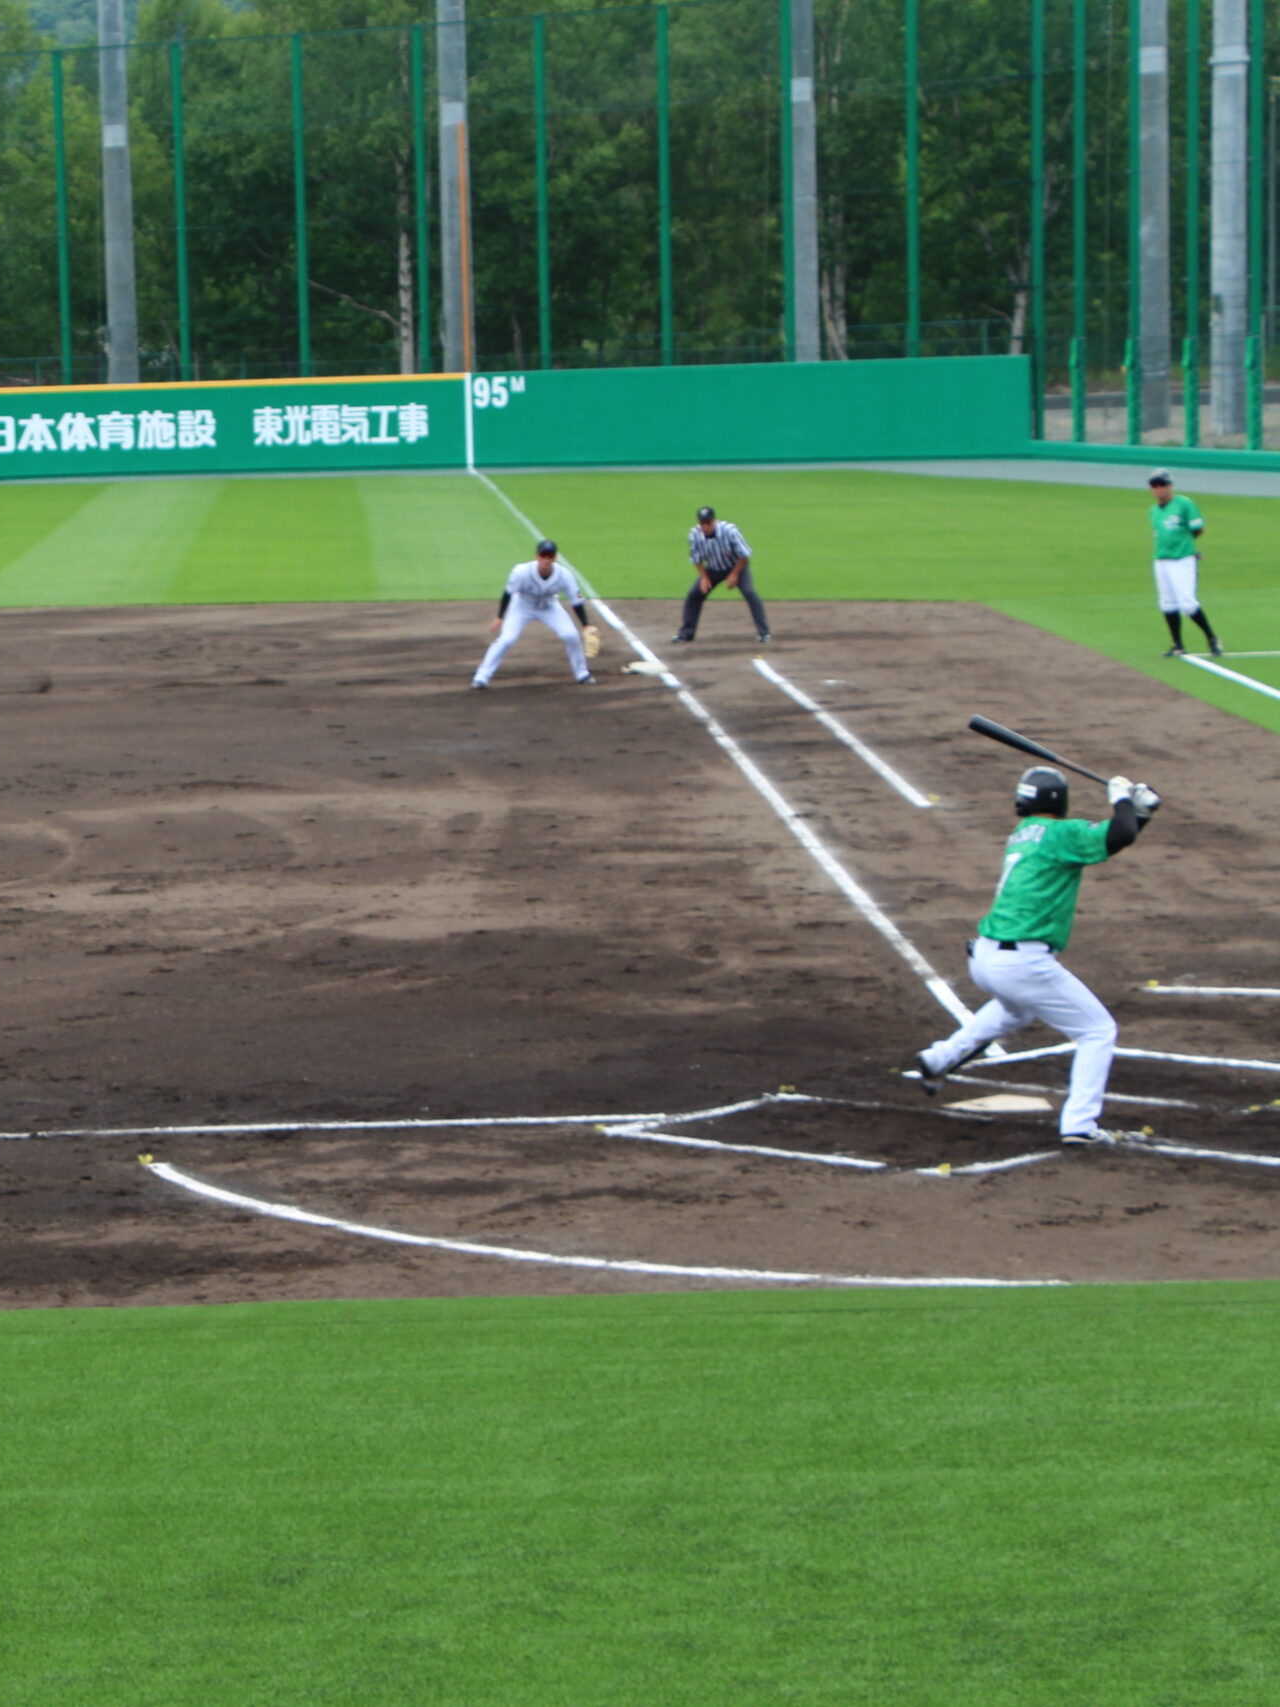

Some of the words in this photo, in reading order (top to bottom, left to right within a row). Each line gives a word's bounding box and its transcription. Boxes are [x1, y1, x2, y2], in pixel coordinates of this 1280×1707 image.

[253, 402, 429, 447] 東光電気工事
